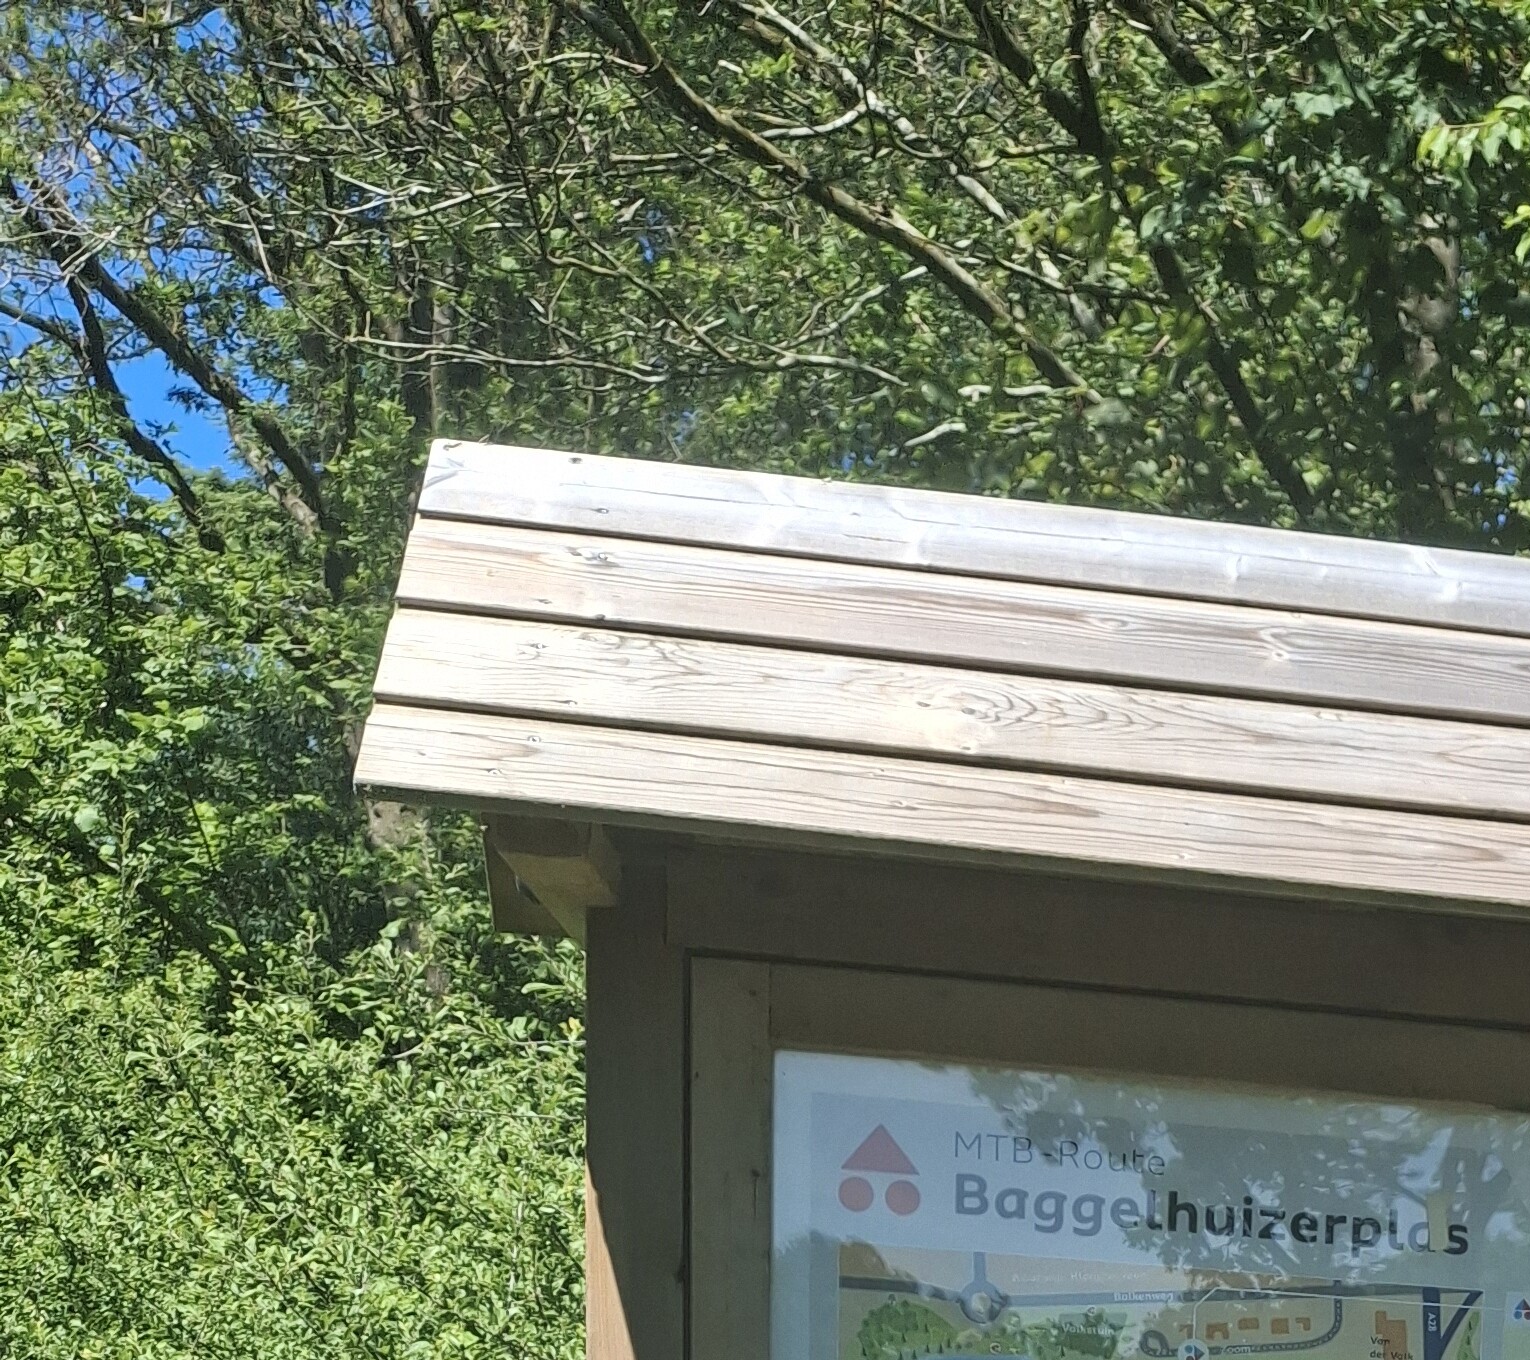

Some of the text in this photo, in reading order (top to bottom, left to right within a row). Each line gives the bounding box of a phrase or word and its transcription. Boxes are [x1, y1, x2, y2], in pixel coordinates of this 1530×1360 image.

[953, 1131, 1166, 1176] MTB-Route
[954, 1172, 1469, 1258] Baggelhuizerplas
[1427, 1312, 1438, 1332] A28
[1370, 1336, 1391, 1346] Van
[1390, 1351, 1414, 1360] Valk
